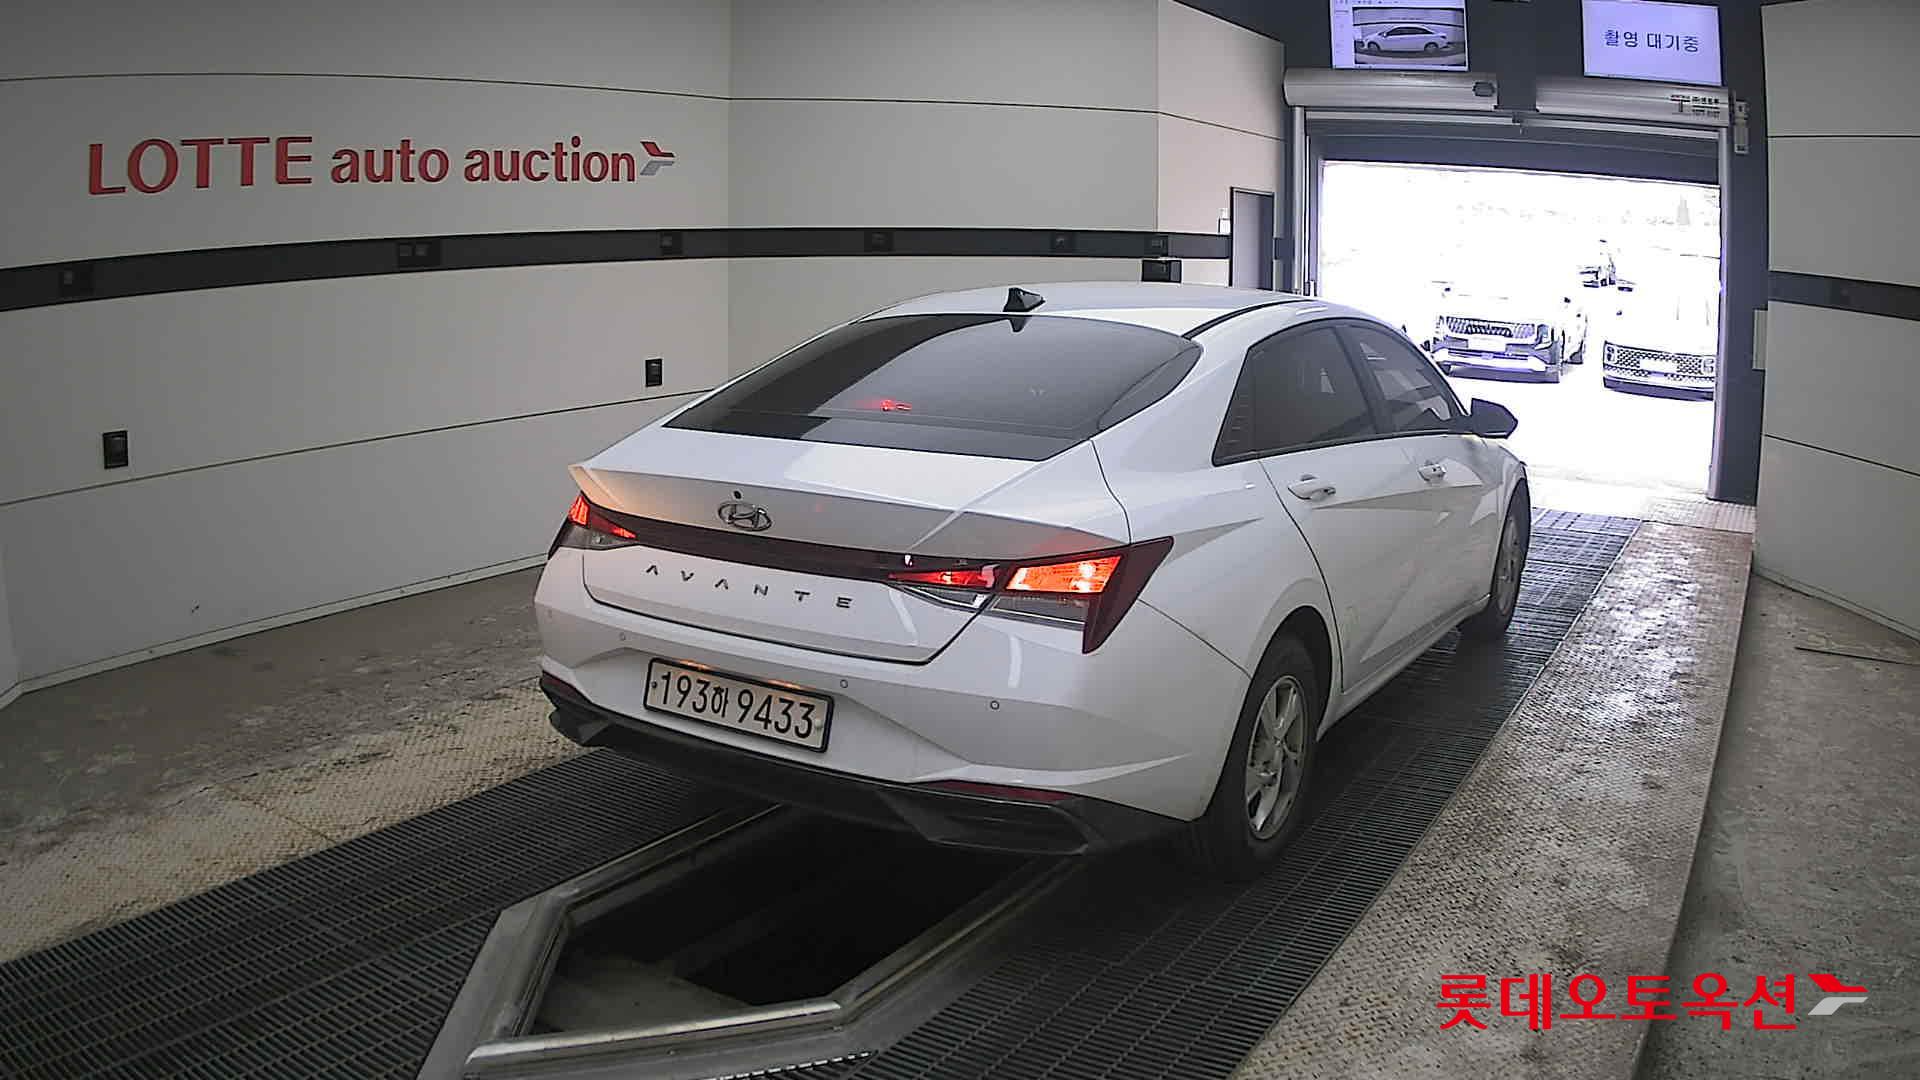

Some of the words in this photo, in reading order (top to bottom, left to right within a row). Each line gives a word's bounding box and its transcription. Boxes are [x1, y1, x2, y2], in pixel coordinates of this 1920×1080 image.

[1647, 33, 1699, 53] 대기중
[88, 136, 312, 195] LOTTE
[330, 138, 449, 185] auto
[463, 135, 637, 183] auction
[646, 564, 853, 609] AVANTE
[660, 671, 729, 719] 193하
[737, 689, 816, 739] 9433
